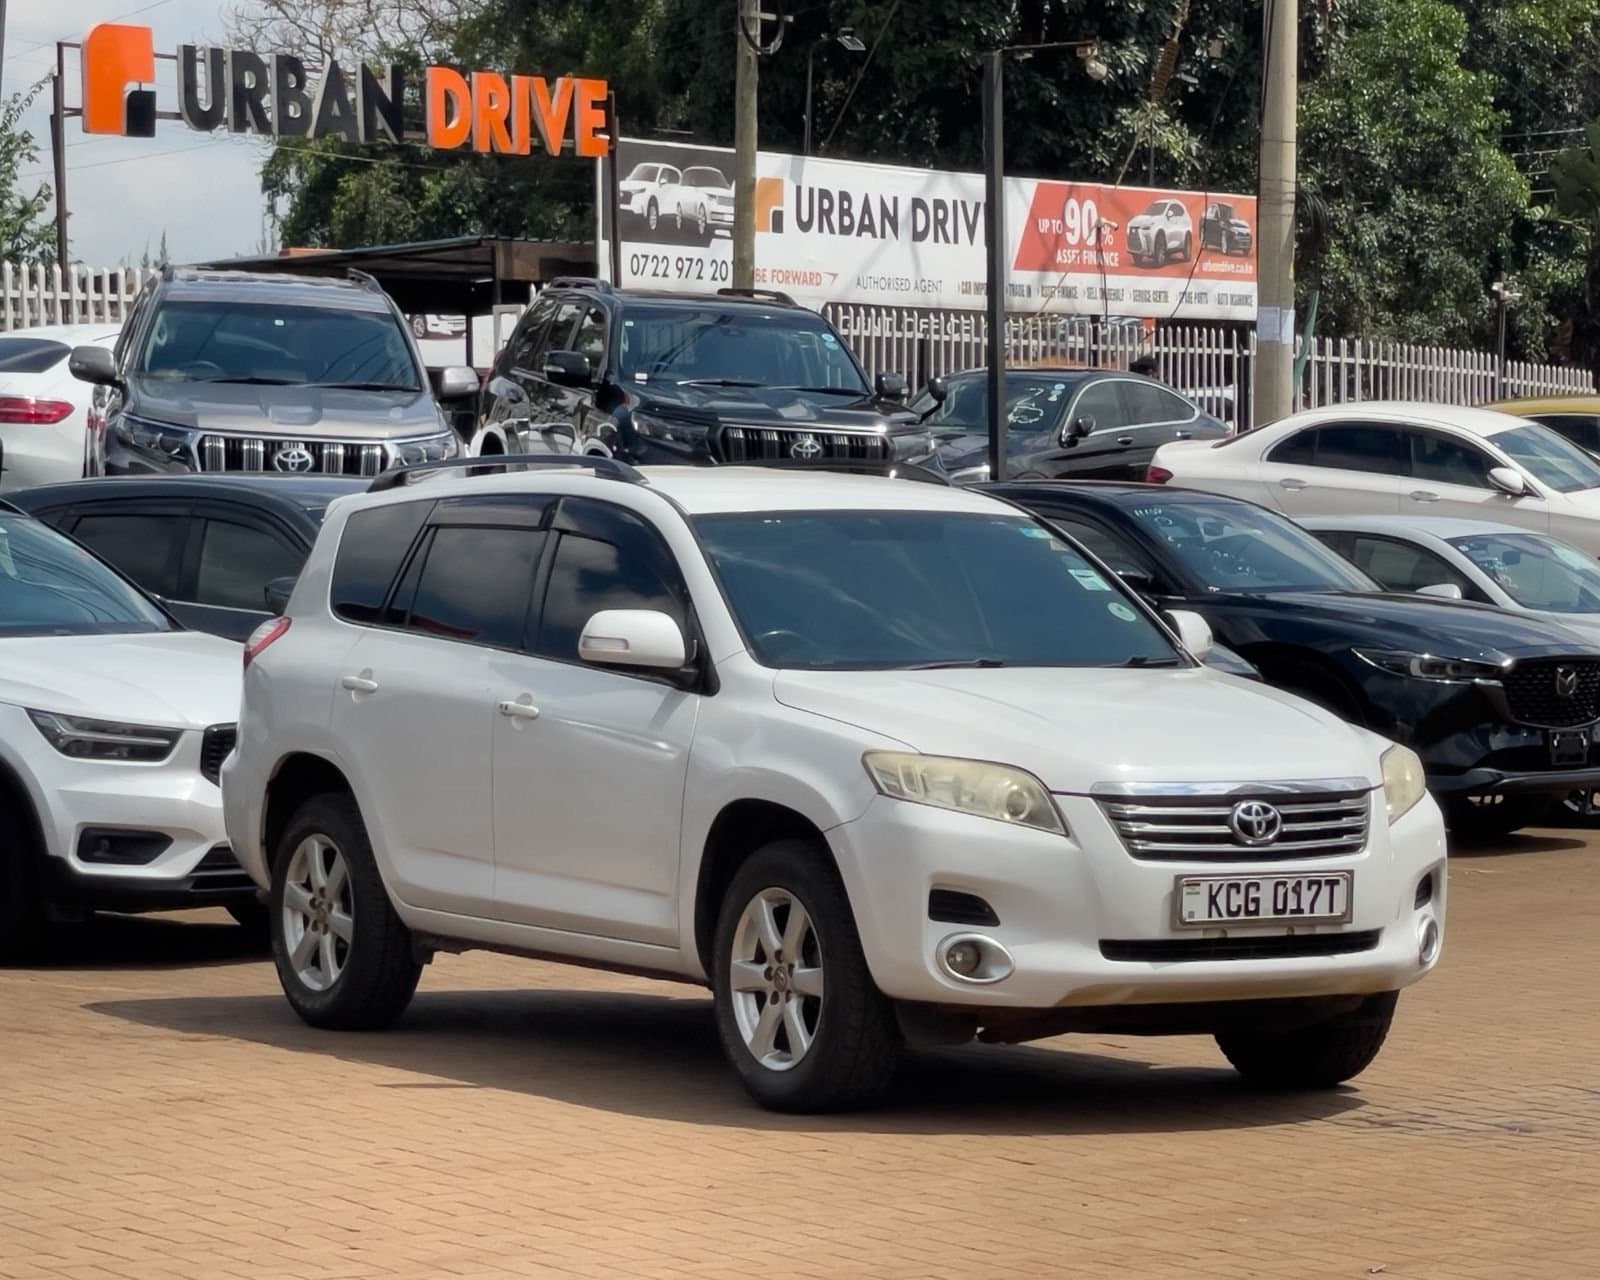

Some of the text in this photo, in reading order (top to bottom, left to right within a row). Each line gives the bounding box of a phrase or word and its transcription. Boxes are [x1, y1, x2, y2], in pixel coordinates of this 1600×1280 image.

[177, 44, 609, 157] URBAN DRIVE
[795, 185, 987, 247] URBAN DRIV
[1038, 218, 1050, 233] UP
[1051, 219, 1063, 234] TO
[630, 253, 733, 282] 0722 972 20
[1055, 248, 1081, 264] ASSET
[754, 267, 822, 286] BE FORWARD
[856, 275, 943, 294] AUTHORISED AGENT
[1207, 879, 1340, 918] KCG 017T
